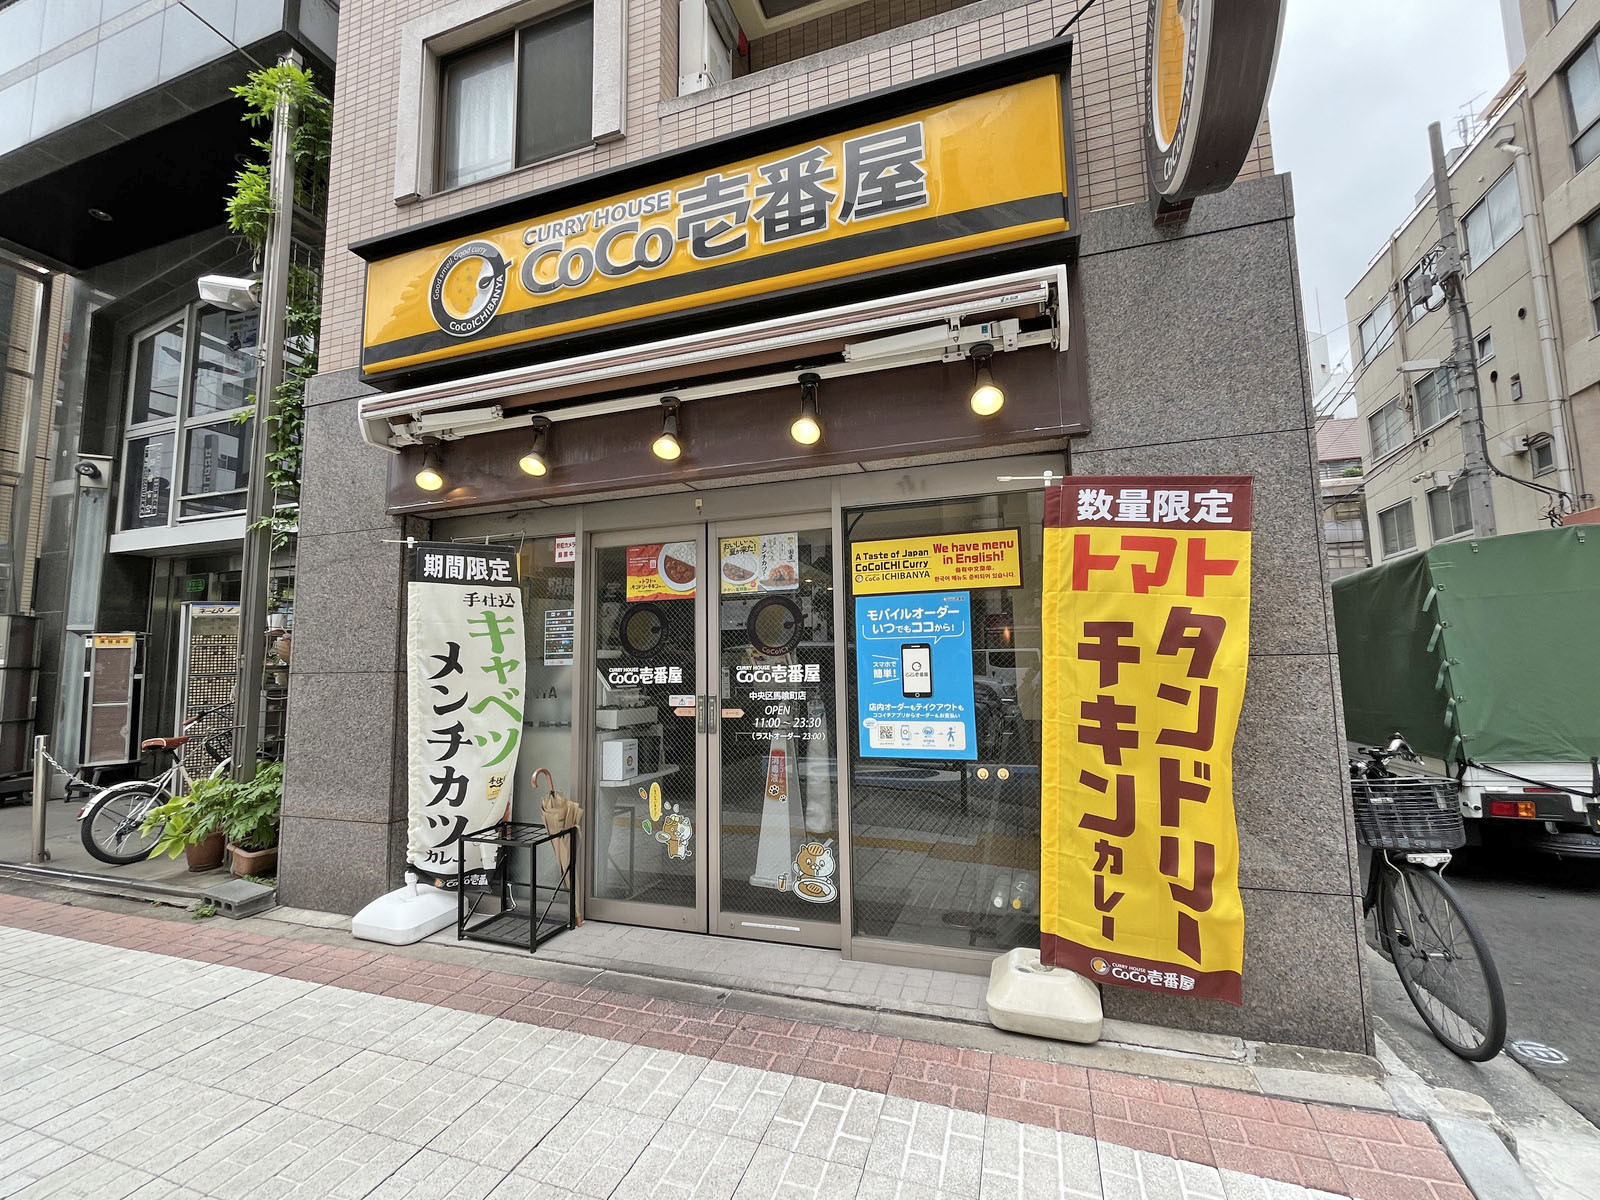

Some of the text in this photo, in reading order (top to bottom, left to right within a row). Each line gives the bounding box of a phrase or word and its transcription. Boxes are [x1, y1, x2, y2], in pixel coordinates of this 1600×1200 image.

[520, 121, 929, 295] CoCo壱番屋
[523, 190, 671, 247] CURRY HOUSE
[433, 277, 442, 300] Good
[449, 274, 504, 331] CoCoICHIBANYA
[1077, 489, 1233, 523] 数量限定
[863, 552, 888, 560] Taste
[891, 550, 899, 558] of
[902, 549, 929, 557] Japan
[933, 540, 1014, 553] We have menu
[855, 560, 929, 572] CoCoICHI Curry
[943, 550, 1004, 564] in English!
[1072, 534, 1239, 597] トマト
[424, 553, 512, 582] 期間限定
[882, 571, 930, 581] ICHIBANYA
[463, 592, 515, 608] 手仕込
[867, 605, 960, 621] モバイルオーダー
[608, 666, 682, 684] CoCo壱番屋
[736, 664, 820, 683] CoCo壱番屋
[467, 610, 522, 768] キャベツ
[764, 705, 791, 715] OPEN
[868, 703, 964, 711] 店内オーダーもテイクアウトも
[754, 717, 780, 728] 11:00
[793, 717, 822, 728] 23:30
[425, 641, 473, 848] メンチカツ
[1155, 607, 1226, 965] タンドリー
[1112, 967, 1195, 991] CoCo壱番屋
